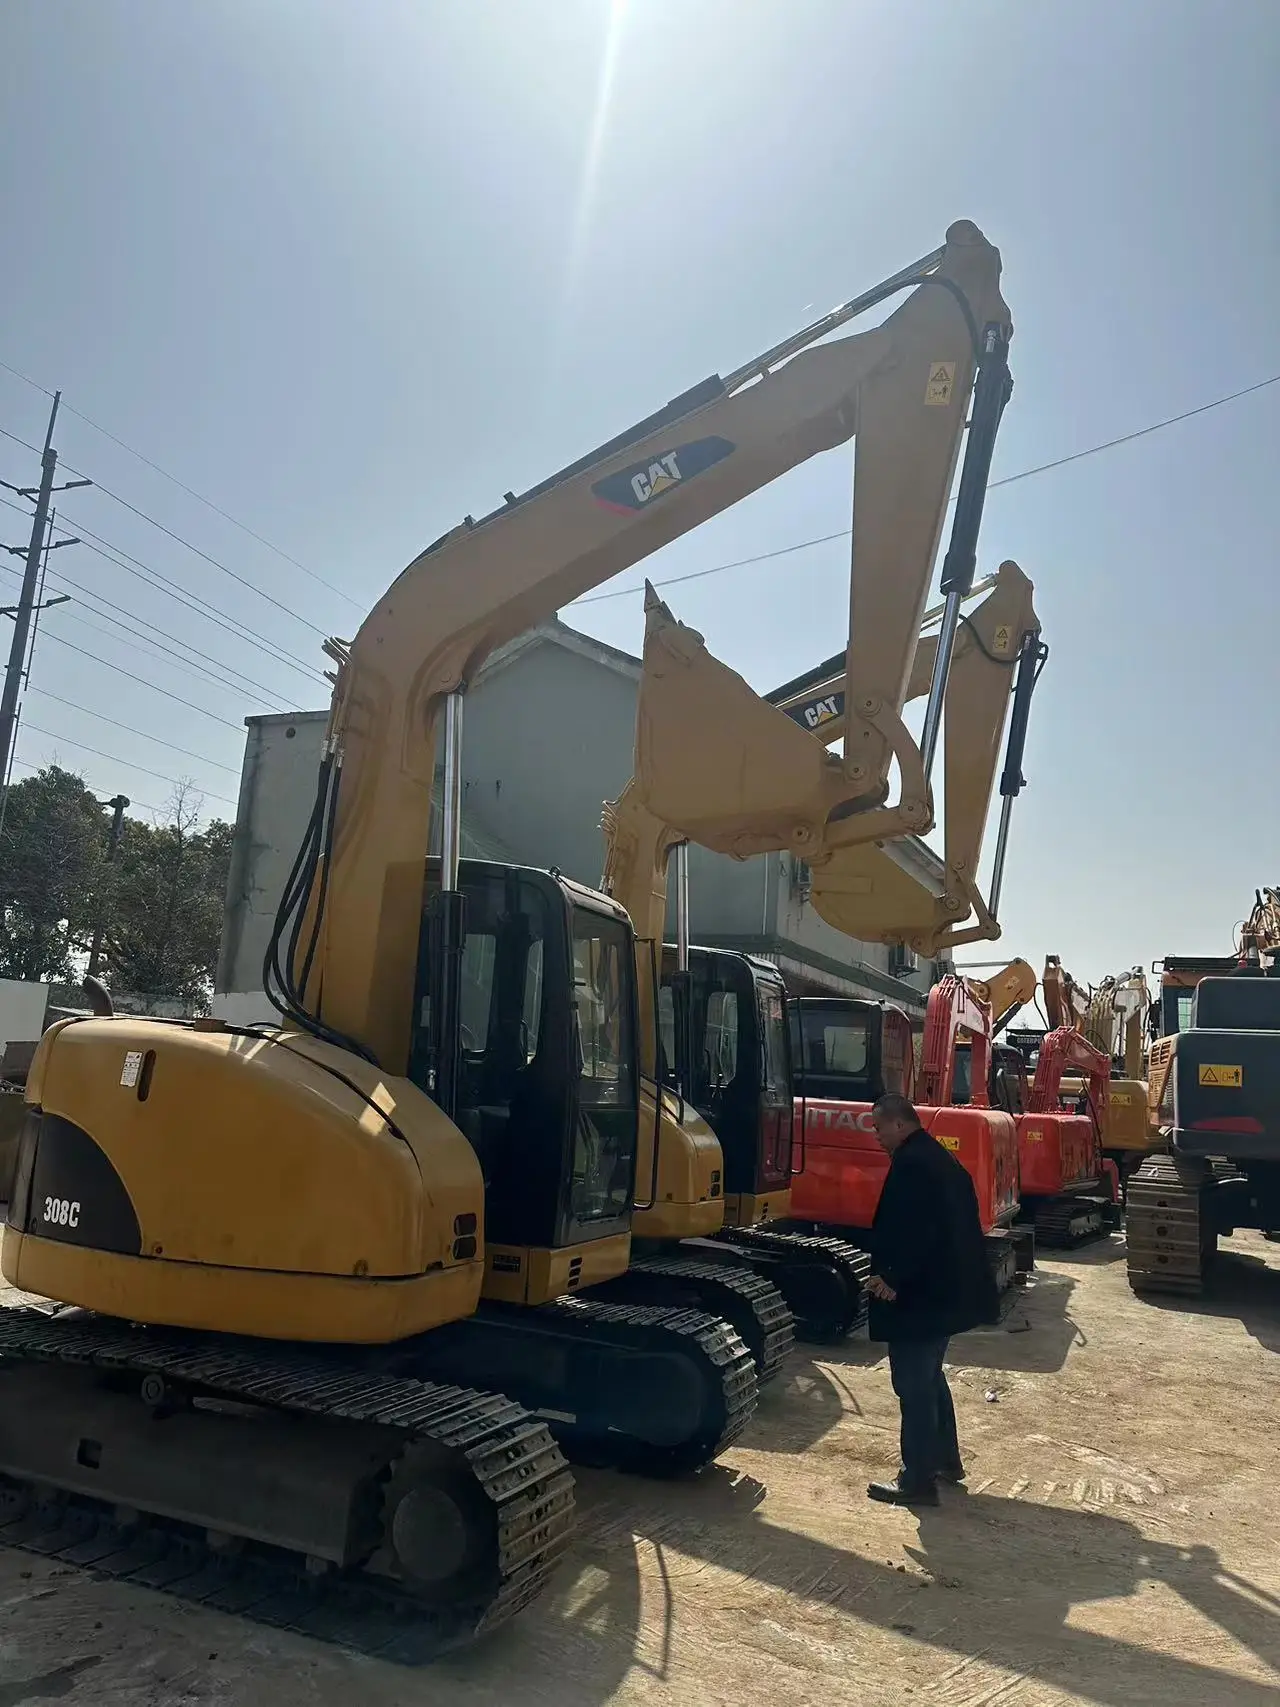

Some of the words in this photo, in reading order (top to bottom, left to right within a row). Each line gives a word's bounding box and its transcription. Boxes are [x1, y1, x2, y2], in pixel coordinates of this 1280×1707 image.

[631, 451, 682, 502] CAT
[804, 695, 839, 727] CAT
[44, 1196, 81, 1228] 308C
